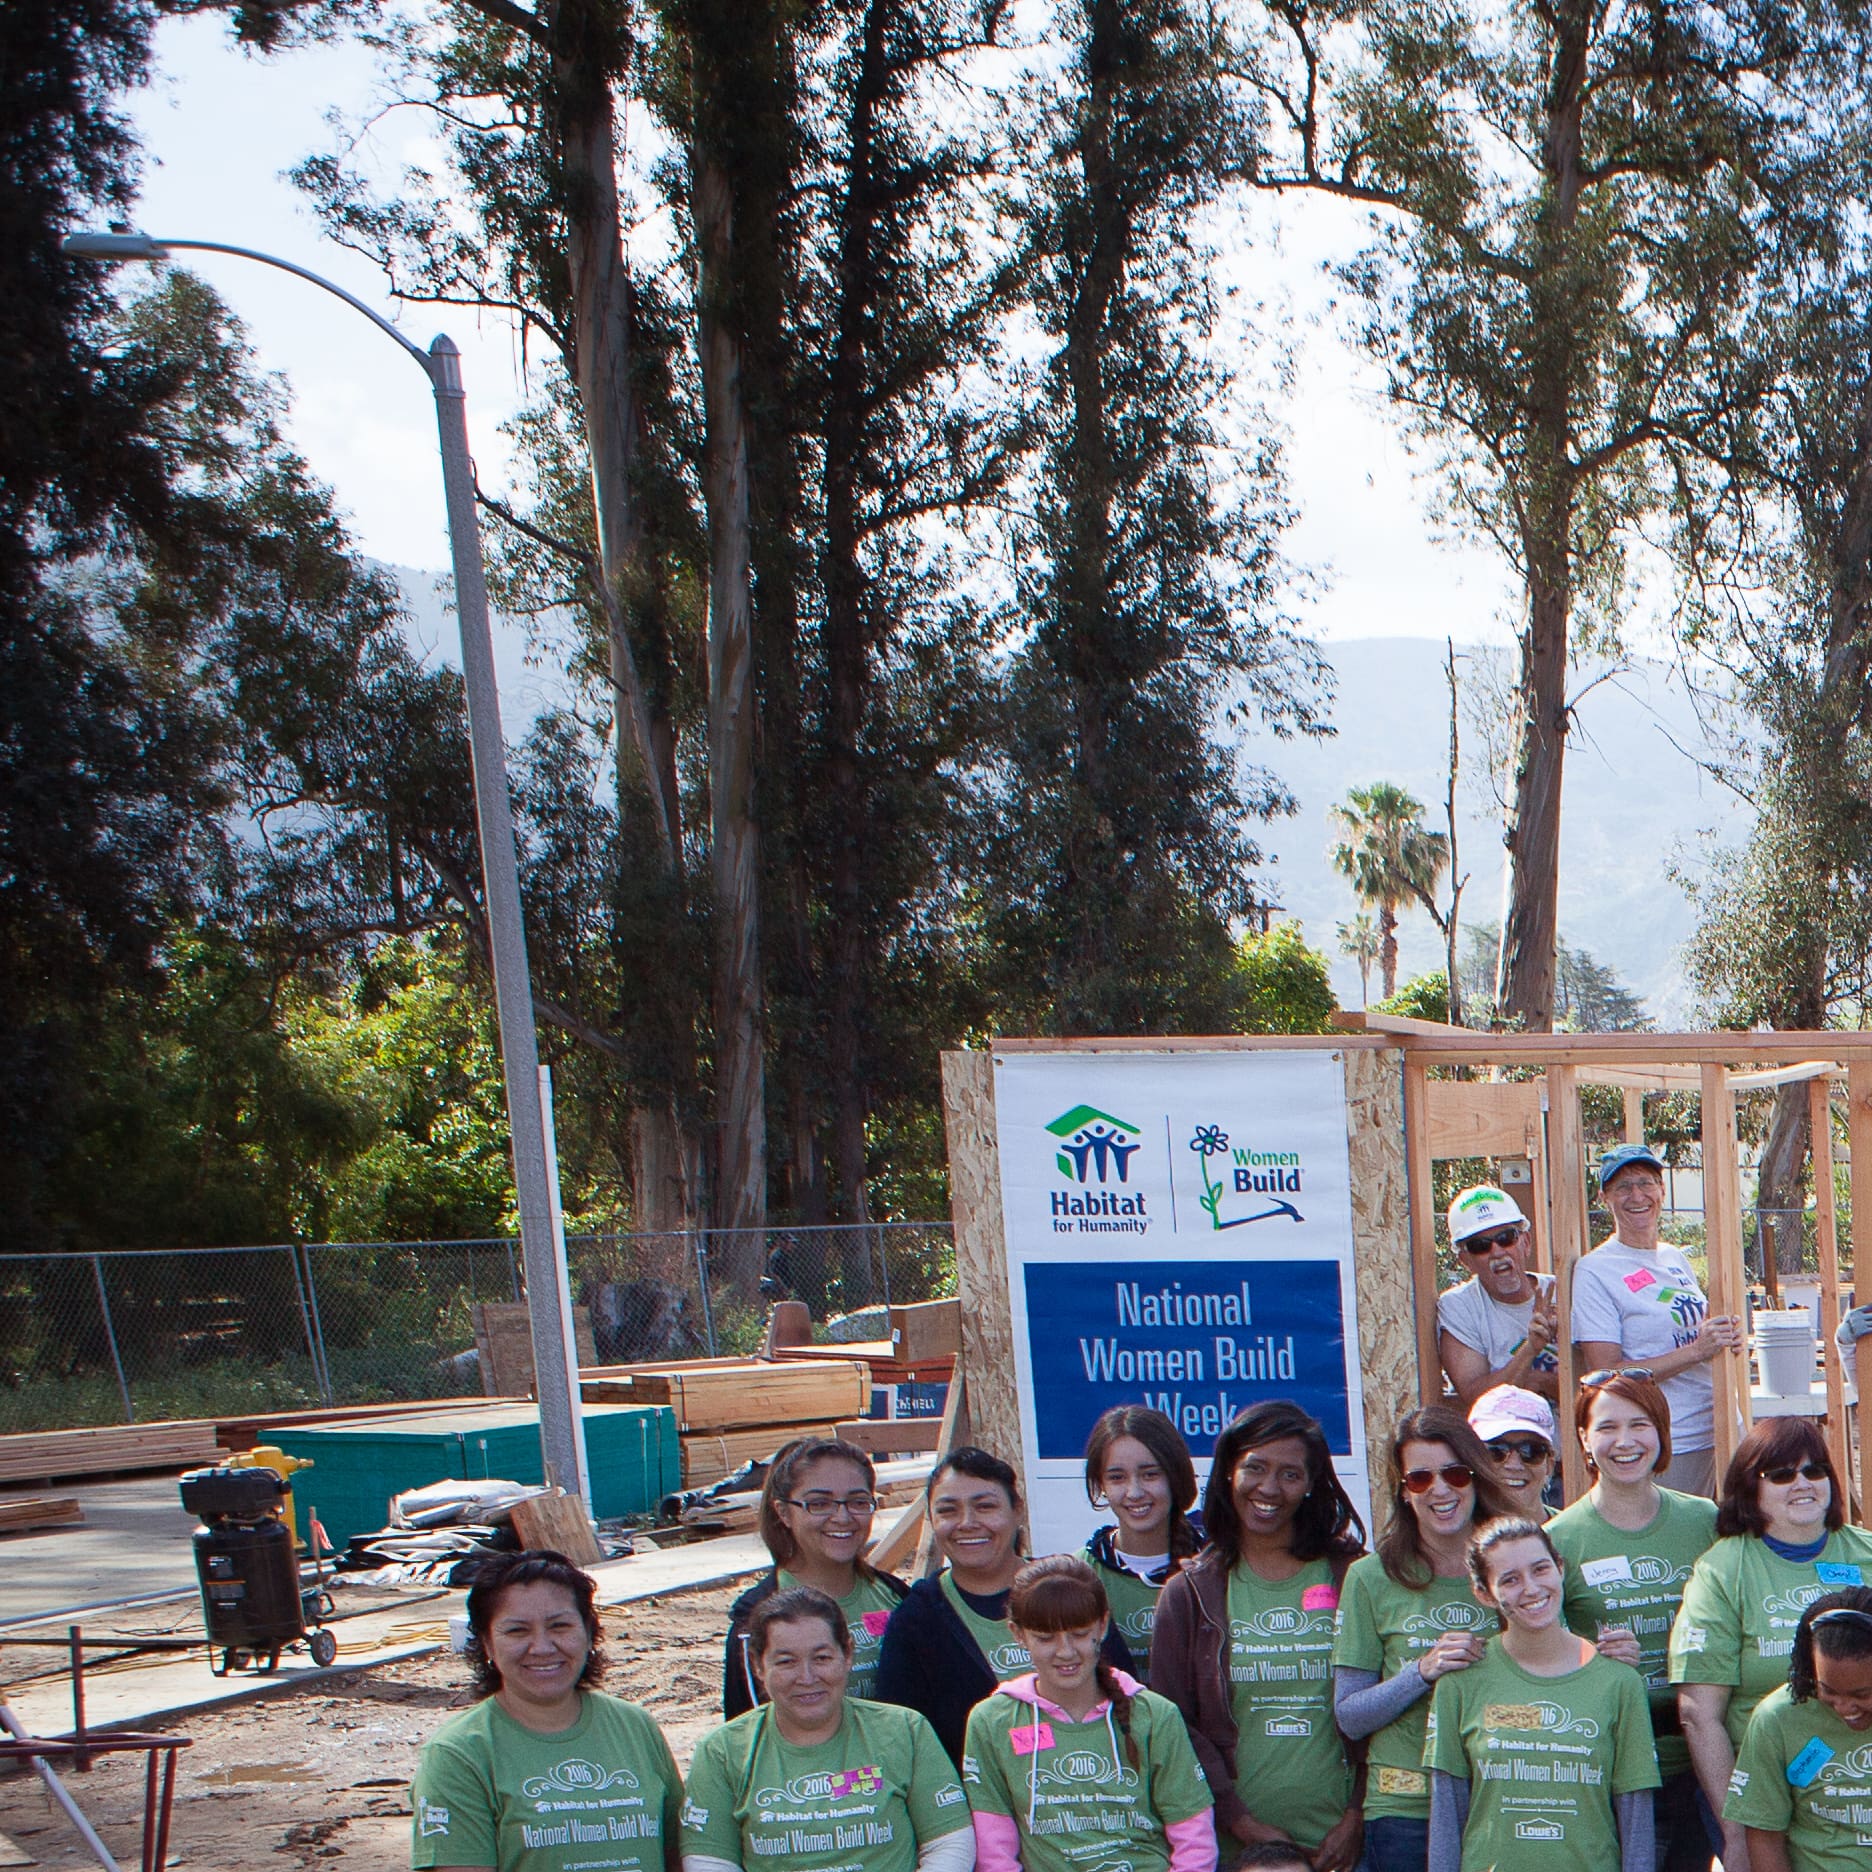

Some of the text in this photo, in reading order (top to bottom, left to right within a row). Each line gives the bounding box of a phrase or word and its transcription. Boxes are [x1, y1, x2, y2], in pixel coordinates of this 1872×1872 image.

[1233, 1149, 1299, 1166] Women
[1051, 1191, 1146, 1216] Habitat
[1053, 1220, 1075, 1233] for
[1116, 1281, 1251, 1327] National
[1080, 1337, 1296, 1382] Women Build
[1637, 1562, 1660, 1579] 2016
[1269, 1612, 1295, 1630] 2016
[1445, 1606, 1471, 1625] 2016
[1632, 1614, 1667, 1636] Women
[1259, 1660, 1329, 1680] Women Build
[1501, 1741, 1533, 1752] Habitat
[1535, 1741, 1548, 1752] for
[566, 1766, 592, 1784] 2016
[1069, 1756, 1096, 1776] 2016
[1514, 1759, 1578, 1783] Women Build
[804, 1779, 831, 1795] 2016
[553, 1800, 582, 1811] Habitat
[585, 1800, 599, 1809] for
[1512, 1796, 1555, 1808] partnership
[1065, 1811, 1100, 1832] Women
[522, 1817, 638, 1848] National Women Build
[793, 1826, 896, 1852] Women Build Week
[564, 1862, 572, 1870] in
[574, 1859, 620, 1871] partnership
